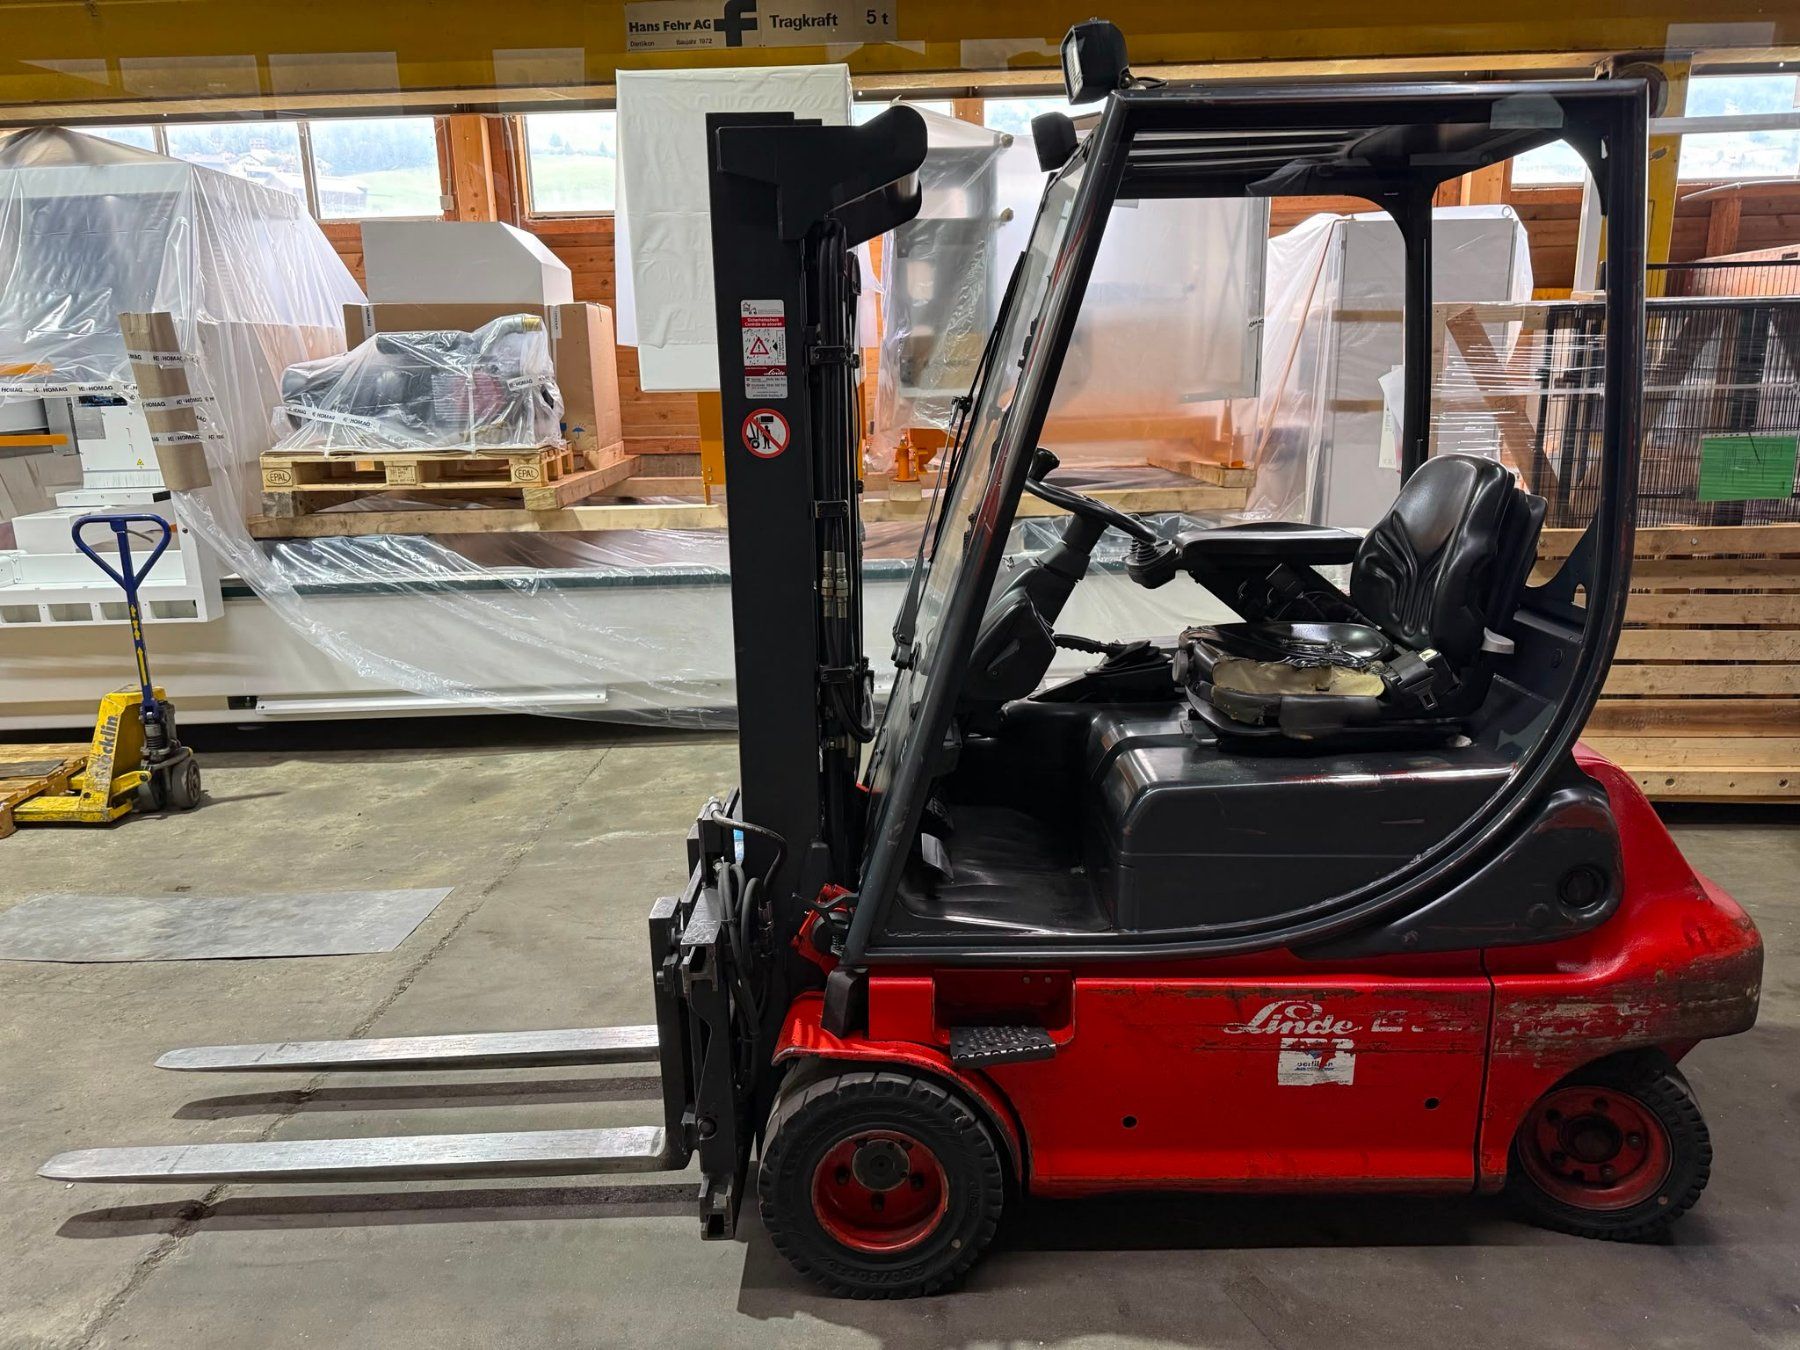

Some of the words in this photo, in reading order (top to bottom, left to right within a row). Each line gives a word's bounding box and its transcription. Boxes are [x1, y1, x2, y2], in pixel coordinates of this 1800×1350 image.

[629, 21, 660, 33] Hans
[663, 20, 691, 31] Fehr
[693, 19, 712, 30] AG
[769, 13, 839, 31] Tragkraft
[866, 9, 877, 25] 5
[882, 12, 889, 25] t
[269, 473, 287, 482] EPAL
[518, 470, 535, 478] EPAL
[1222, 1000, 1363, 1035] Linde
